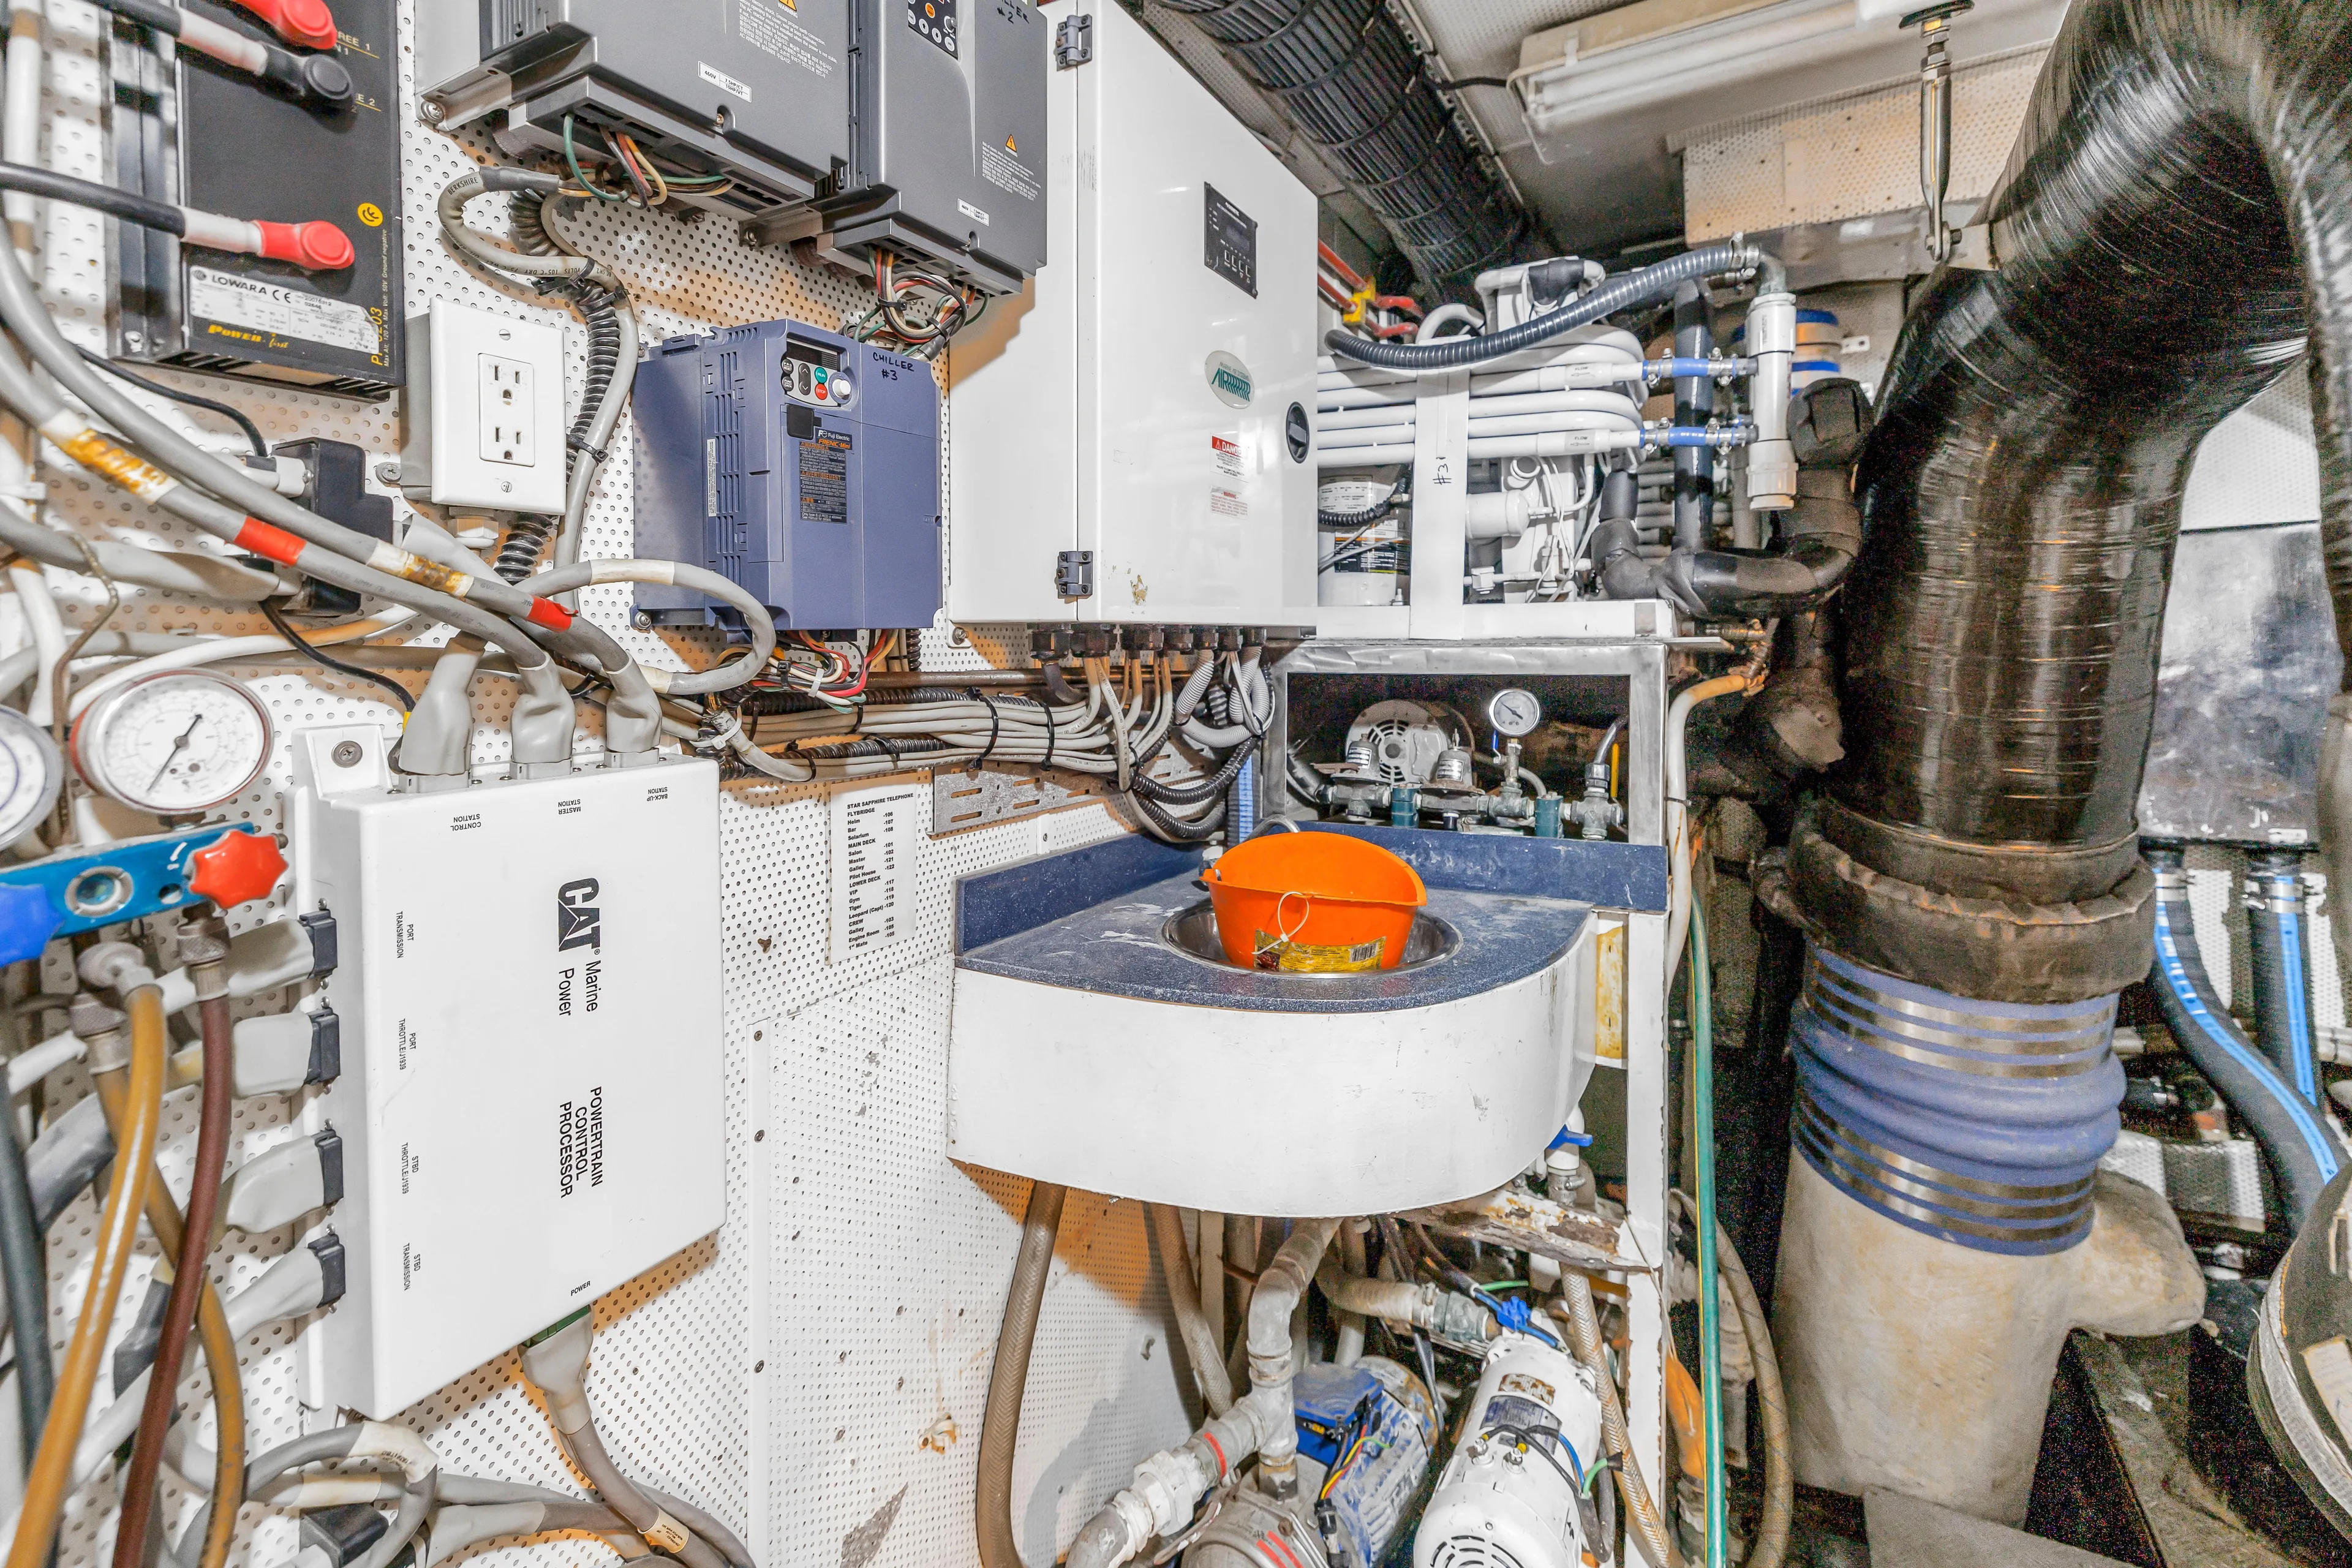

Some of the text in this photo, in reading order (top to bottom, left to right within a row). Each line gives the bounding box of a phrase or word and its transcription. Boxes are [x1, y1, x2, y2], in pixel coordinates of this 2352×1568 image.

[777, 2, 798, 18] WARNING
[447, 176, 479, 195] BERKSHIRE
[212, 274, 268, 295] LOWARA
[873, 352, 915, 372] CHILLER
[881, 369, 898, 381] #3
[647, 794, 668, 802] BACK-UP
[648, 786, 668, 795] STATION
[862, 798, 886, 807] SAPPHIRE
[887, 793, 914, 802] TELEPHONE
[453, 814, 480, 823] STATION
[847, 807, 875, 817] FLYBRIDGE
[450, 821, 481, 831] CONTROL
[848, 832, 869, 841] Solarium
[850, 879, 867, 888] LOWER
[558, 878, 601, 952] CAT
[849, 909, 869, 919] Leopard
[869, 905, 884, 914] (Capt)
[849, 918, 864, 927] CREW
[559, 967, 575, 1016] Power
[586, 960, 601, 1012] Marine
[575, 1106, 588, 1182] CONTROL
[590, 1086, 603, 1188] POWERTRAIN
[559, 1101, 573, 1199] PROCESSOR
[571, 1280, 591, 1297] POWER
